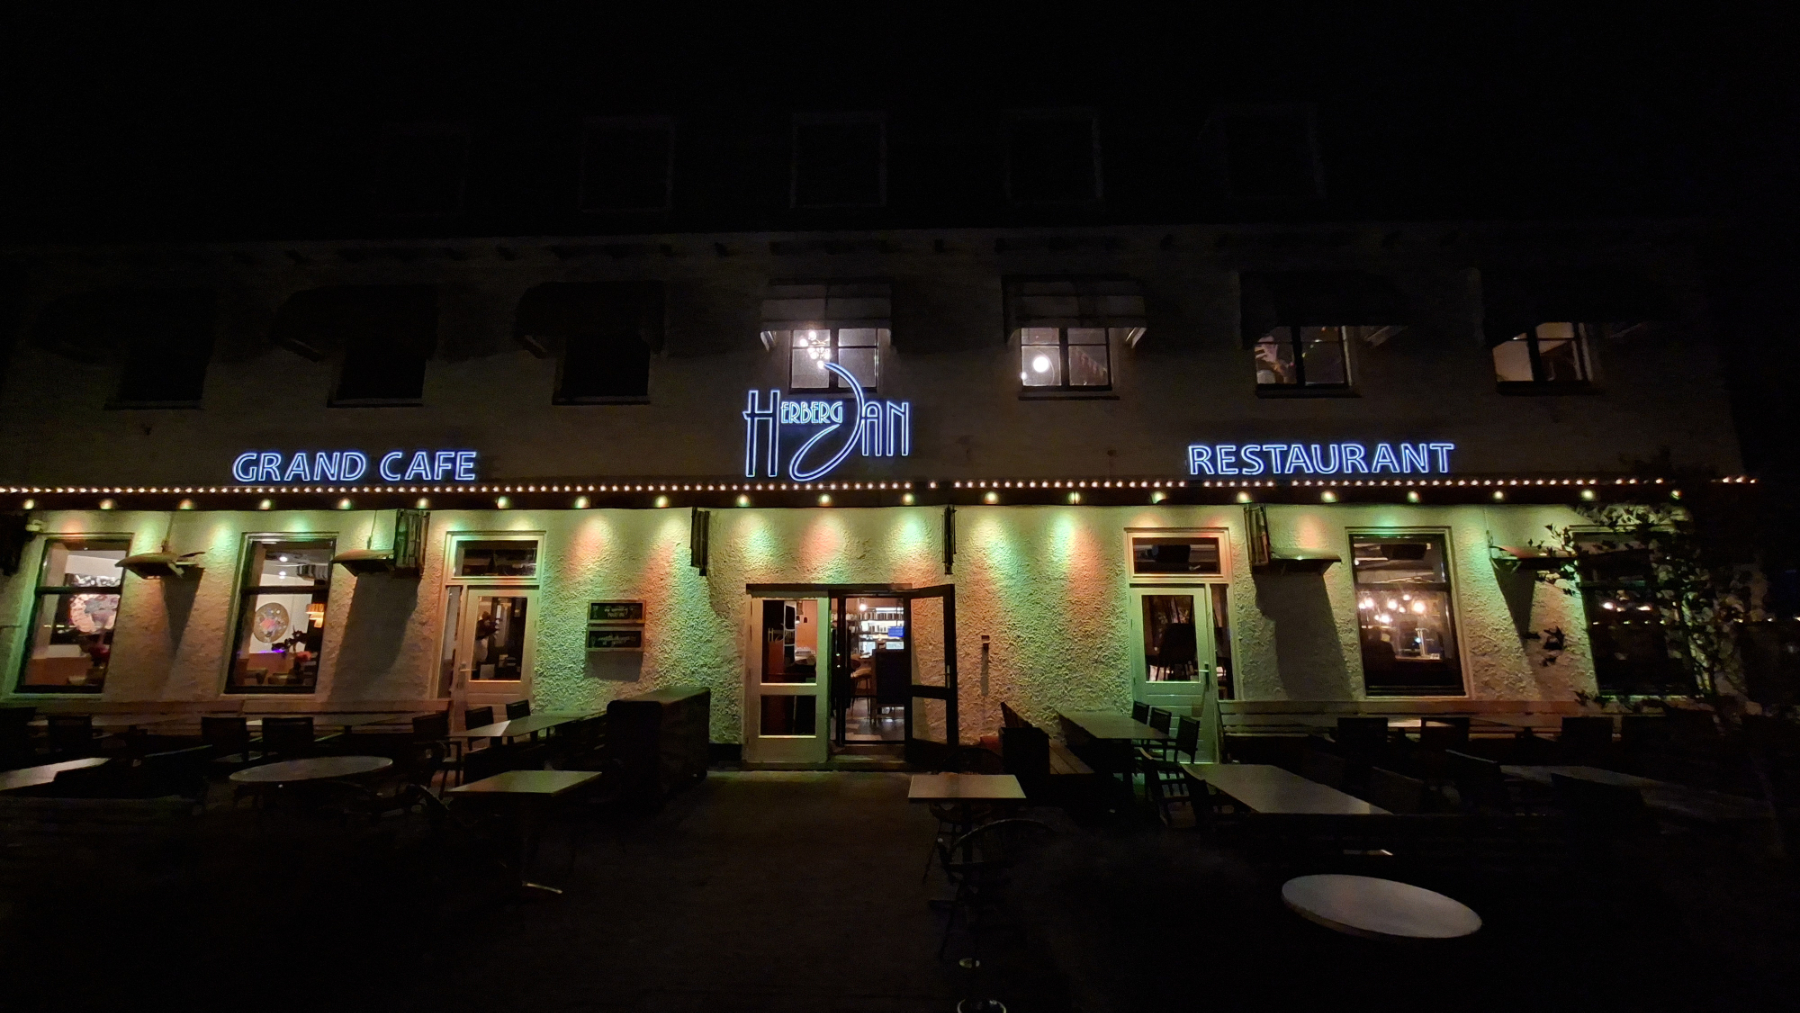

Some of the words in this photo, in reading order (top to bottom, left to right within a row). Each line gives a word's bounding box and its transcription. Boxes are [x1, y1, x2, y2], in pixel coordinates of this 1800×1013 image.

[742, 389, 843, 477] HERBERG
[789, 362, 909, 482] JAN
[232, 452, 367, 482] GRAND
[379, 451, 477, 482] CAFE
[1188, 443, 1455, 475] RESTAURANT
